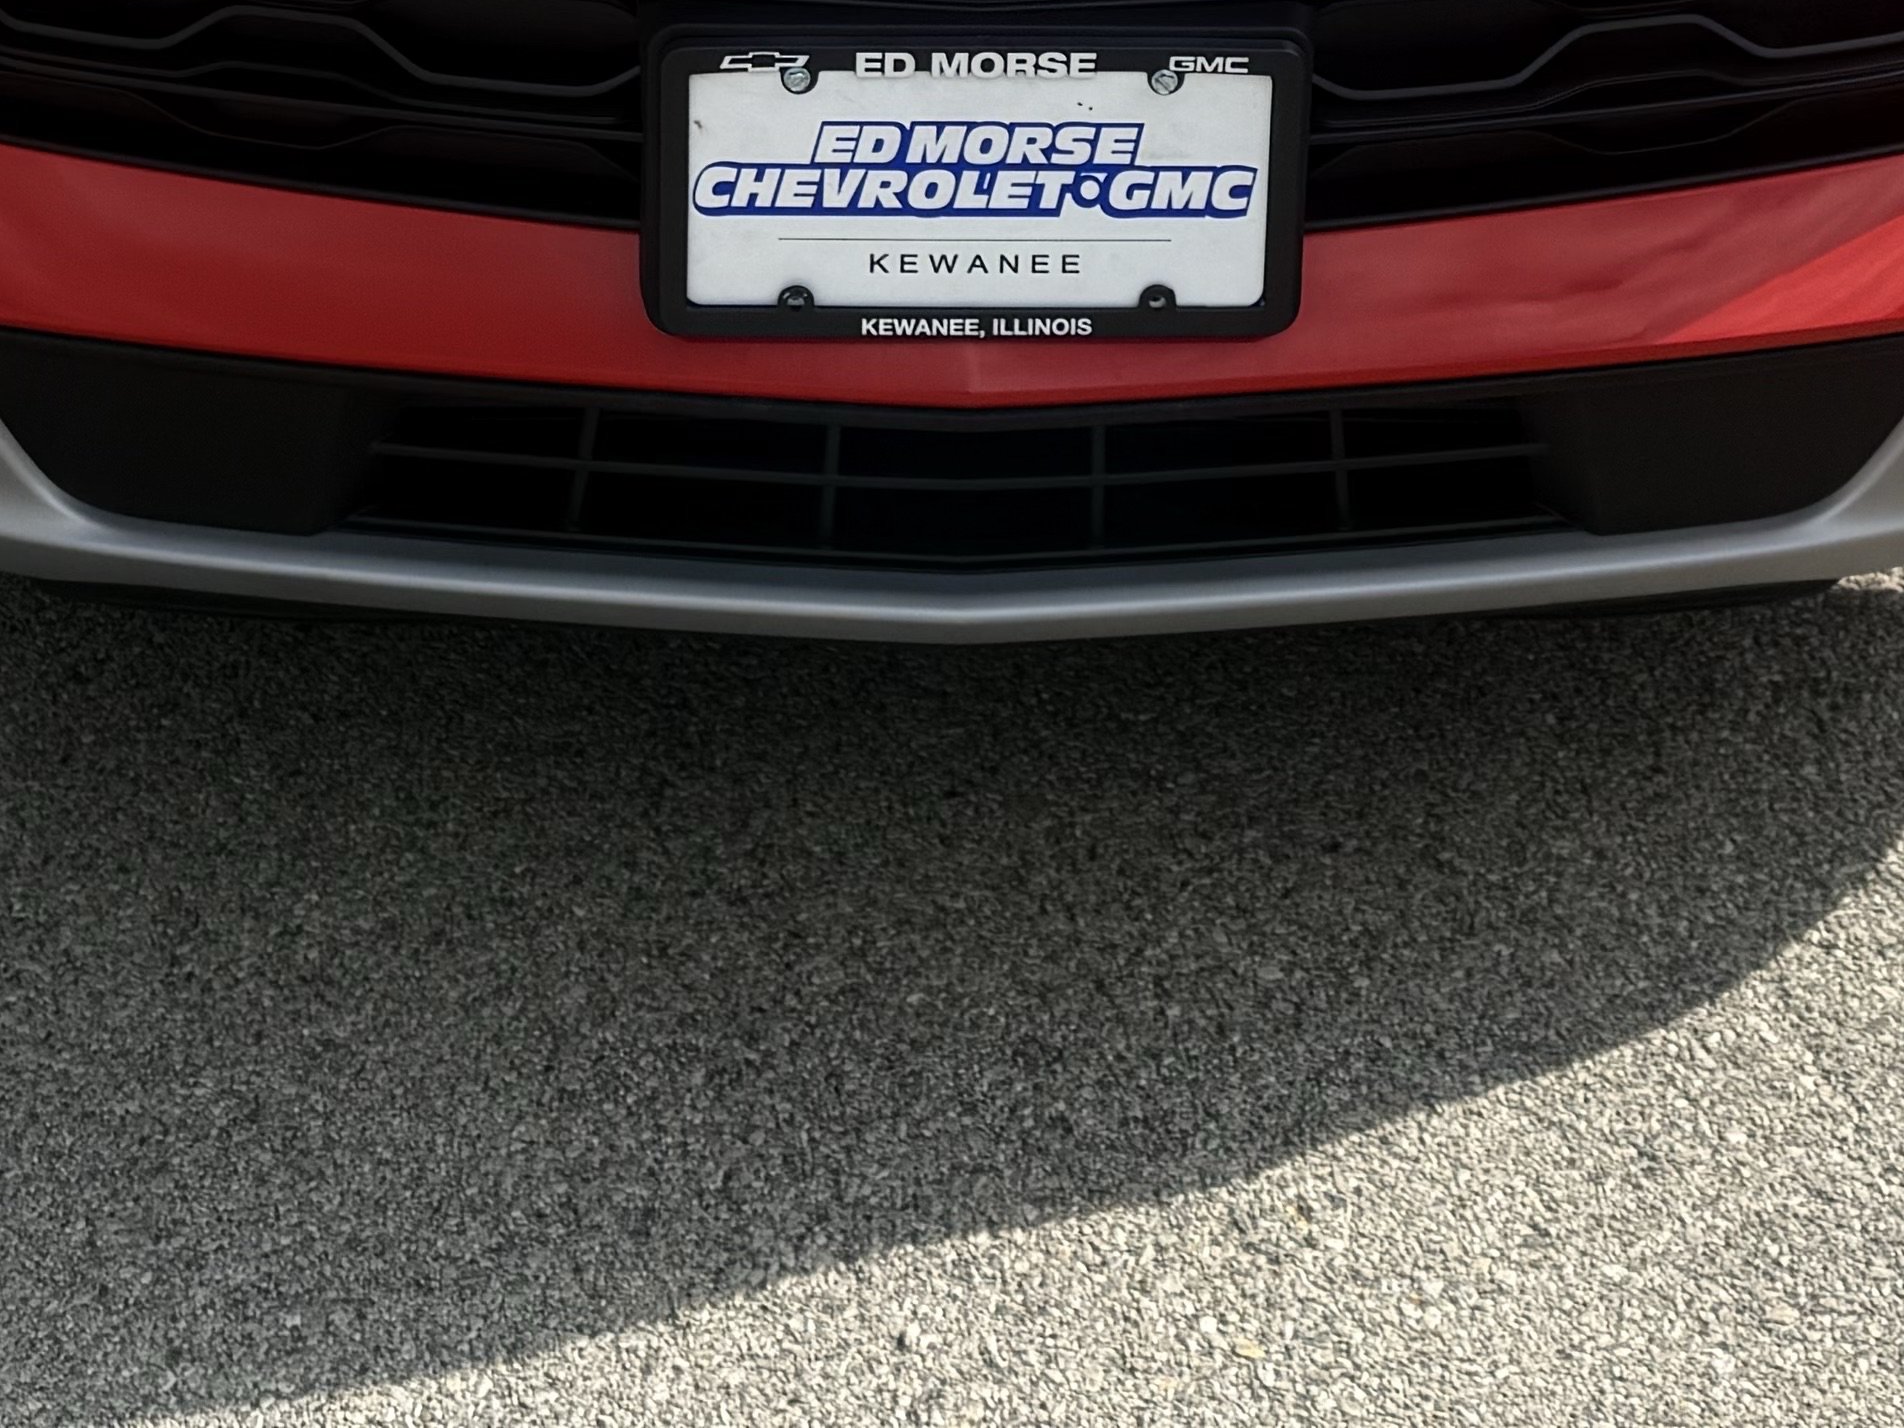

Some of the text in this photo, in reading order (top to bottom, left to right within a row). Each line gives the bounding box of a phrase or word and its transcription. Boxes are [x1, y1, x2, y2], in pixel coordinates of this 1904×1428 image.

[855, 51, 1098, 80] ED MORSE
[1168, 55, 1250, 74] GMC
[813, 124, 1140, 166] ED MORSE
[868, 252, 1081, 275] KEWANEE
[860, 317, 1093, 338] KEWANEE, ILLINOIS
